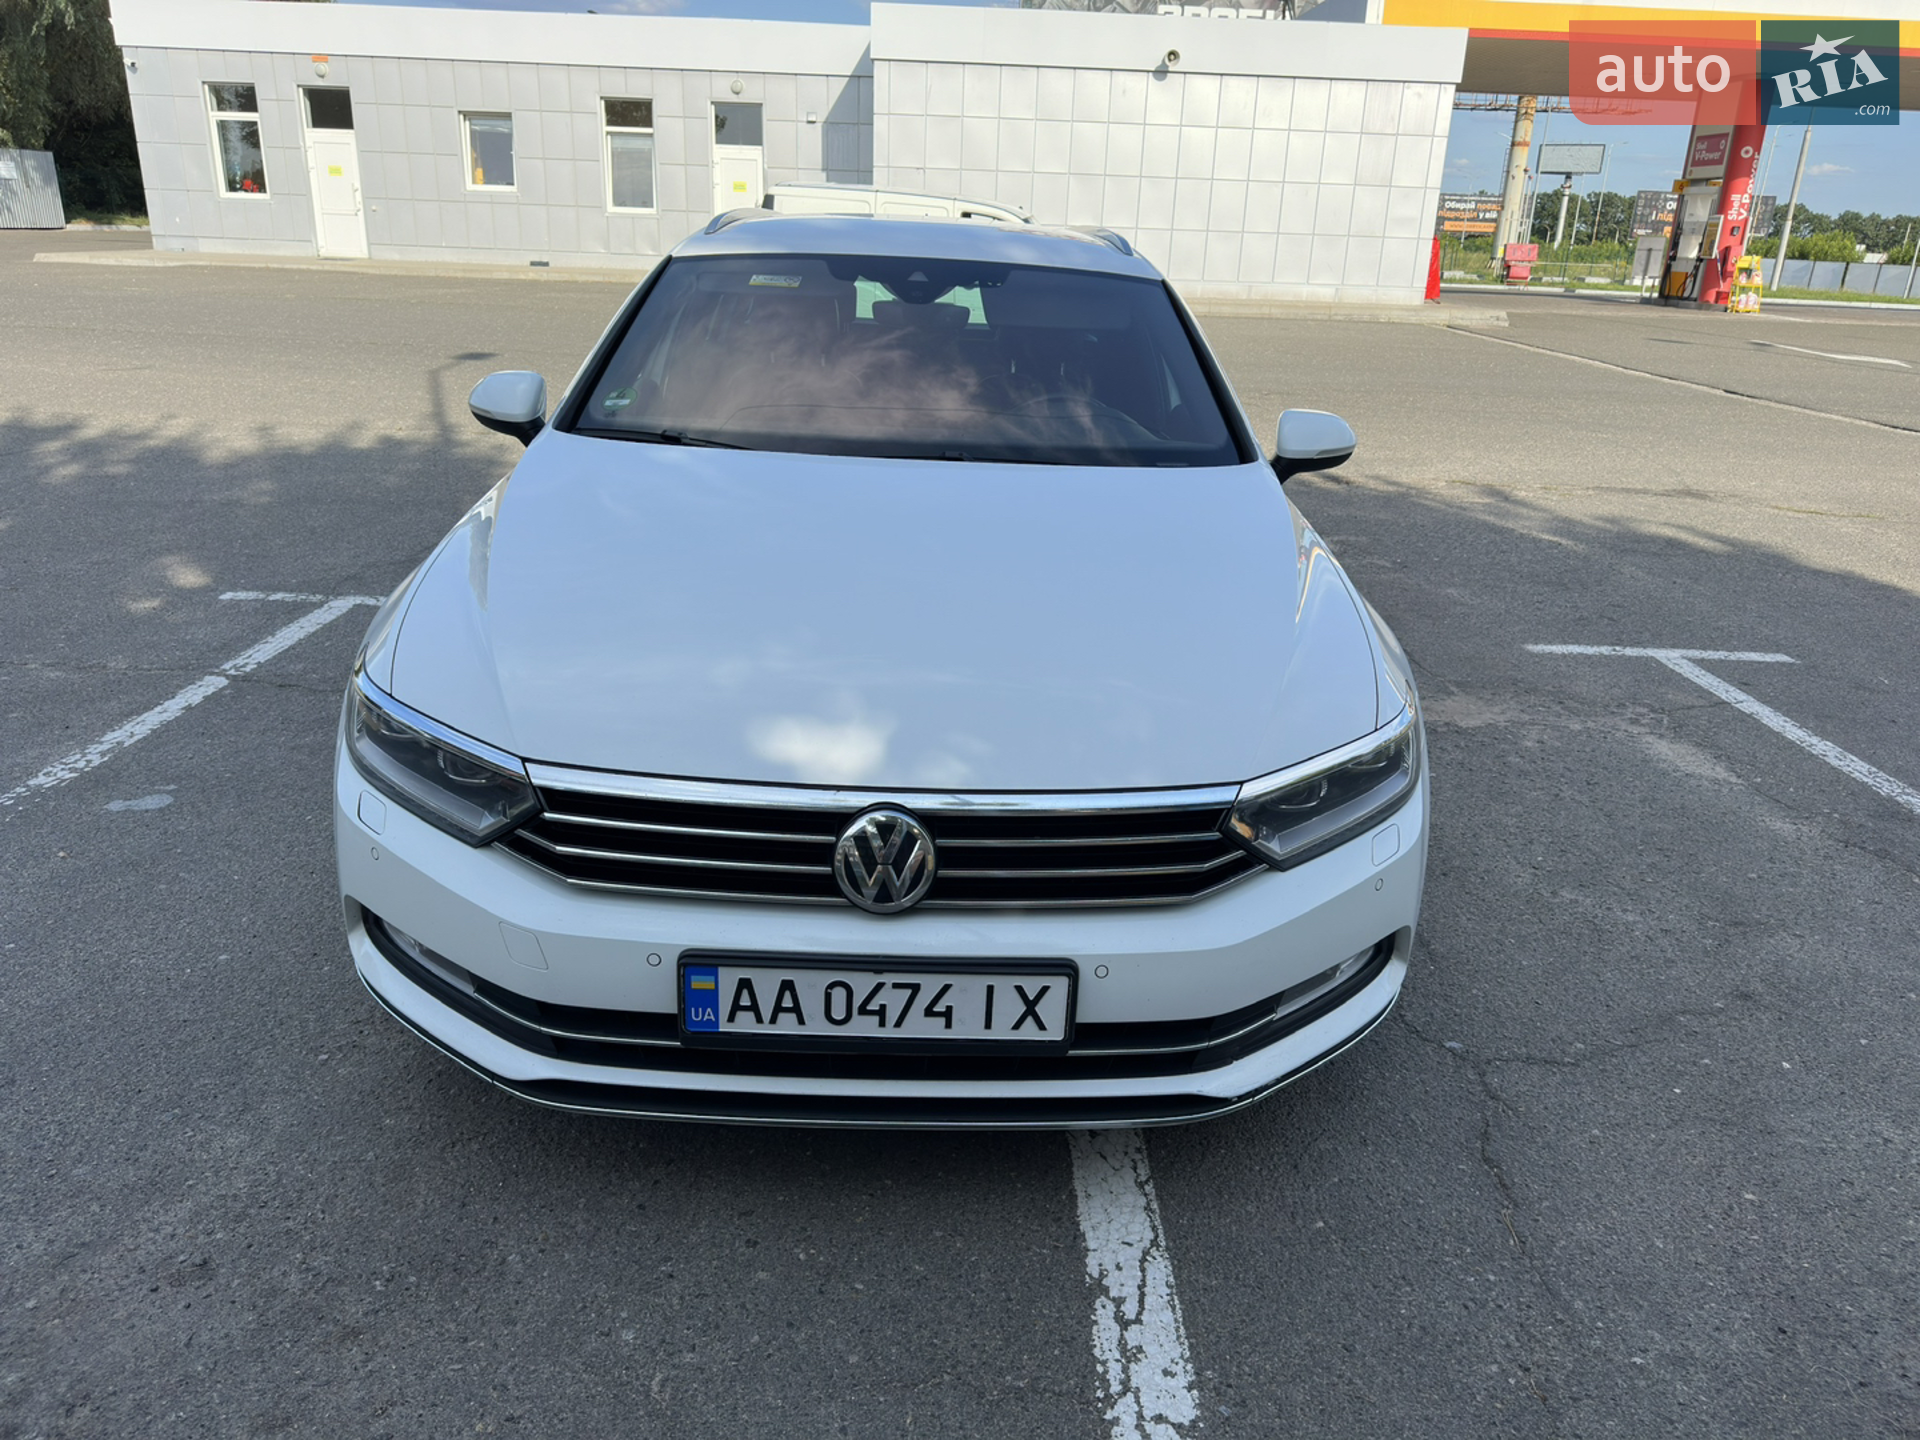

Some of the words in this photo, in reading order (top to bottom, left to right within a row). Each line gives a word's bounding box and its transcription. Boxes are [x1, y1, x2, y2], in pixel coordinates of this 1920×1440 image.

[1738, 151, 1761, 221] V-Power
[1727, 194, 1742, 221] Shell
[691, 1007, 716, 1022] UA
[726, 977, 806, 1025] AA
[824, 979, 954, 1029] 0474
[984, 984, 1051, 1031] IX
